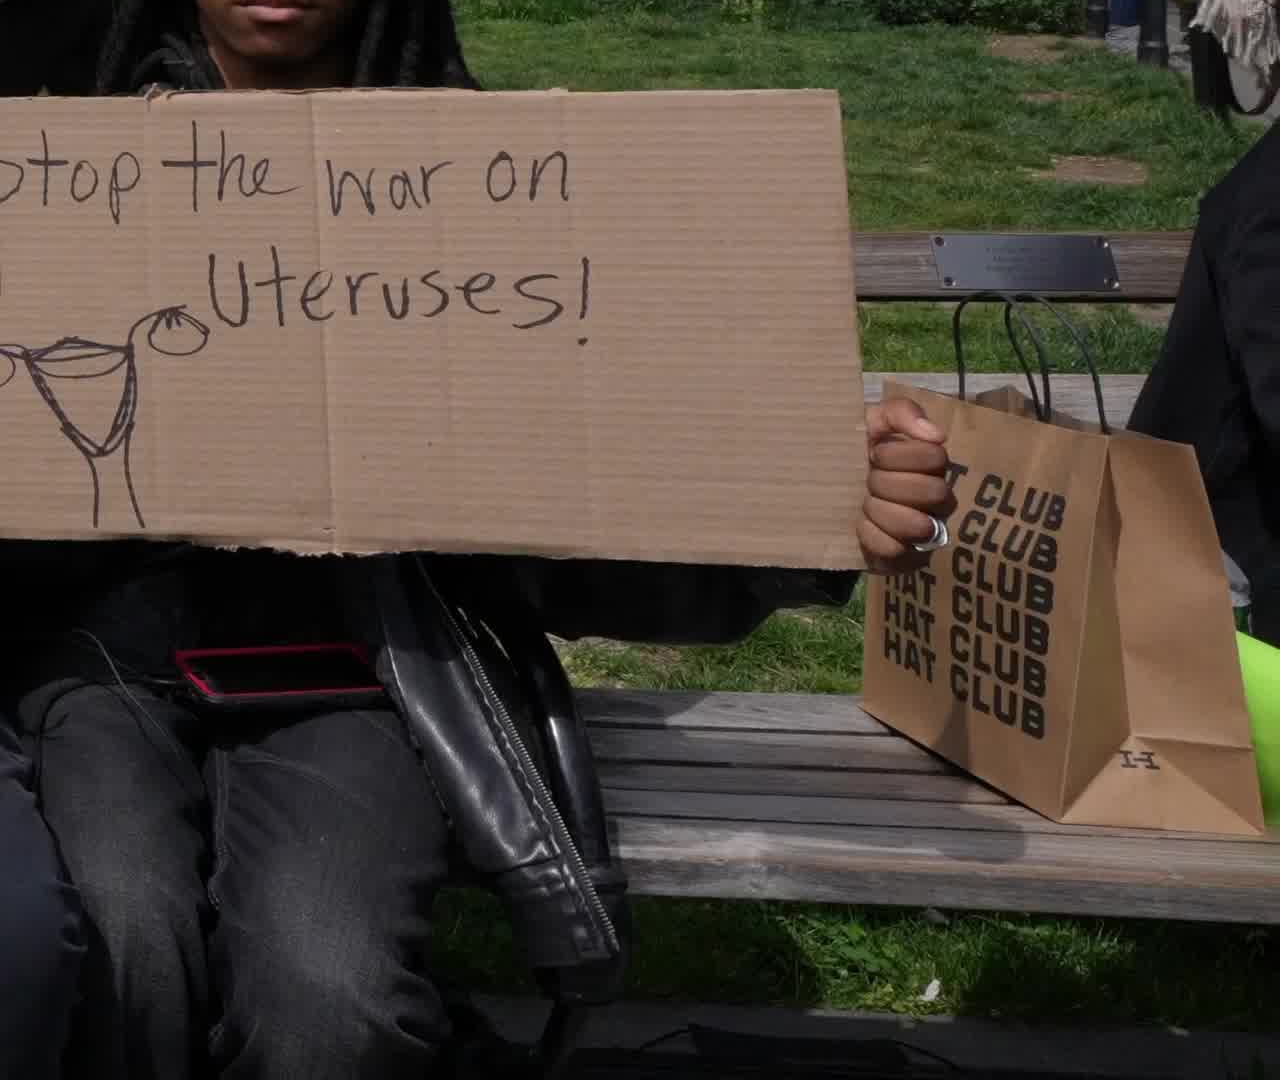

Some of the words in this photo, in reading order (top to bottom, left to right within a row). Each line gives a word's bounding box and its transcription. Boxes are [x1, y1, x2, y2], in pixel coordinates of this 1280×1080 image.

[161, 121, 302, 213] the
[325, 154, 454, 218] war
[487, 148, 571, 205] on
[974, 473, 1067, 532] CLUB
[958, 510, 1058, 573] CLUB
[952, 546, 1054, 615] CLUB
[884, 589, 936, 644] HAT
[950, 624, 1046, 698] CLUB
[952, 585, 1050, 656] CLUB
[884, 626, 936, 683] HAT
[950, 663, 1044, 740] CLUB
